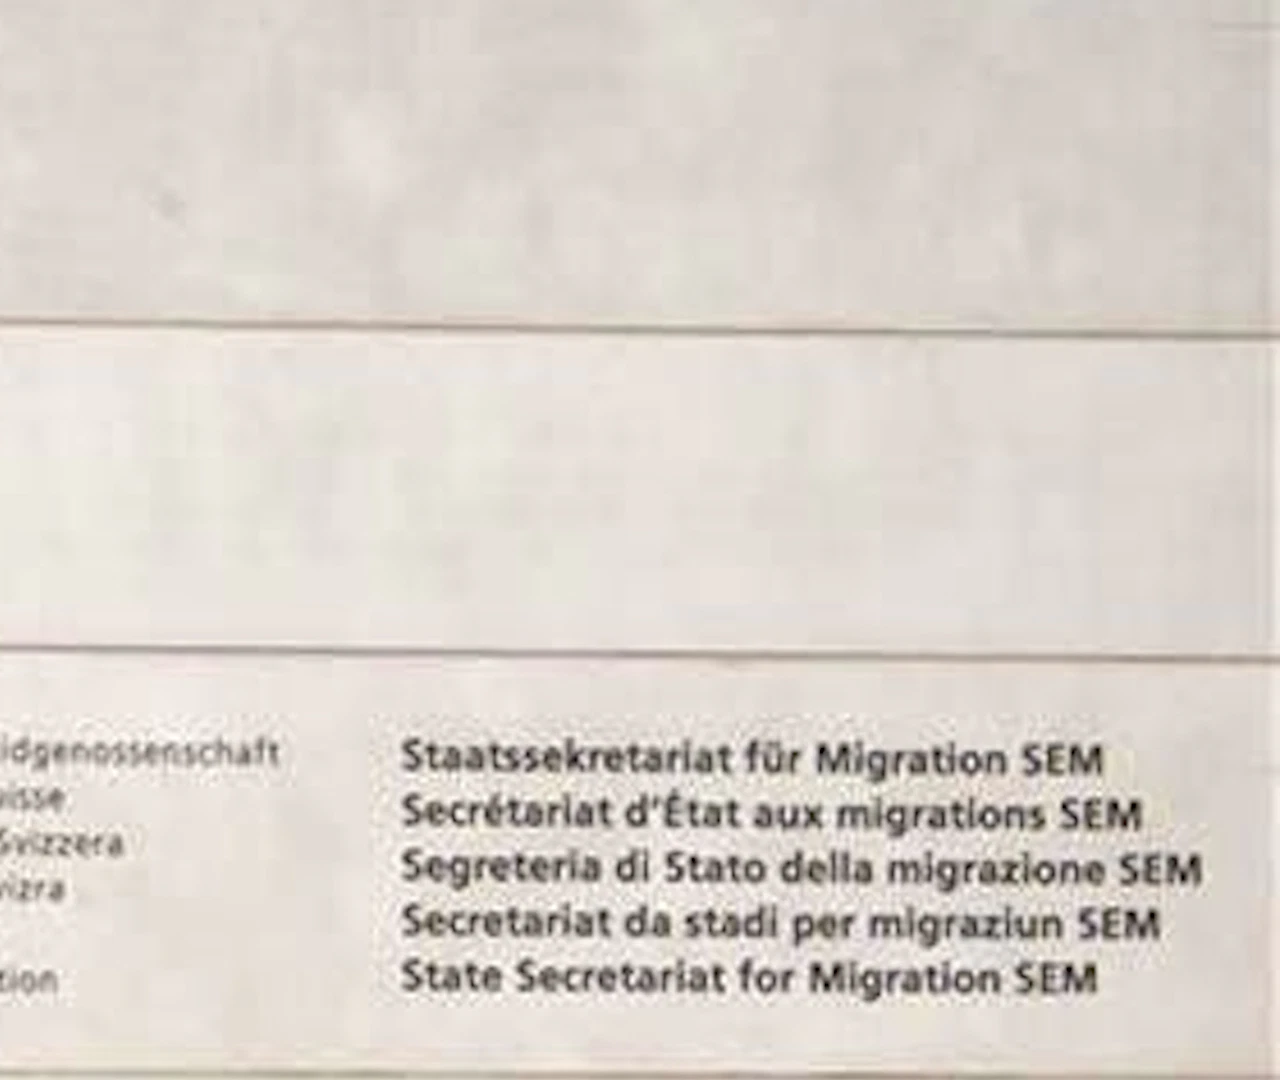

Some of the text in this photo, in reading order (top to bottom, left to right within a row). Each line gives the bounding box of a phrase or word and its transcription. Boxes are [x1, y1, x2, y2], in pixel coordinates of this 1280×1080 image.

[401, 737, 1104, 785] Staatssekretariat für Migration SEM
[401, 792, 613, 830] Secrétariat
[752, 803, 824, 832] aux
[836, 795, 1047, 839] migrations
[1060, 797, 1142, 832] SEM
[401, 847, 1202, 895] Segreteria di Stato della migrazione SEM
[401, 902, 1161, 950] Secretariat da stadi per migraziun SEM
[401, 957, 1098, 1004] State Secretariat for Migration SEM
